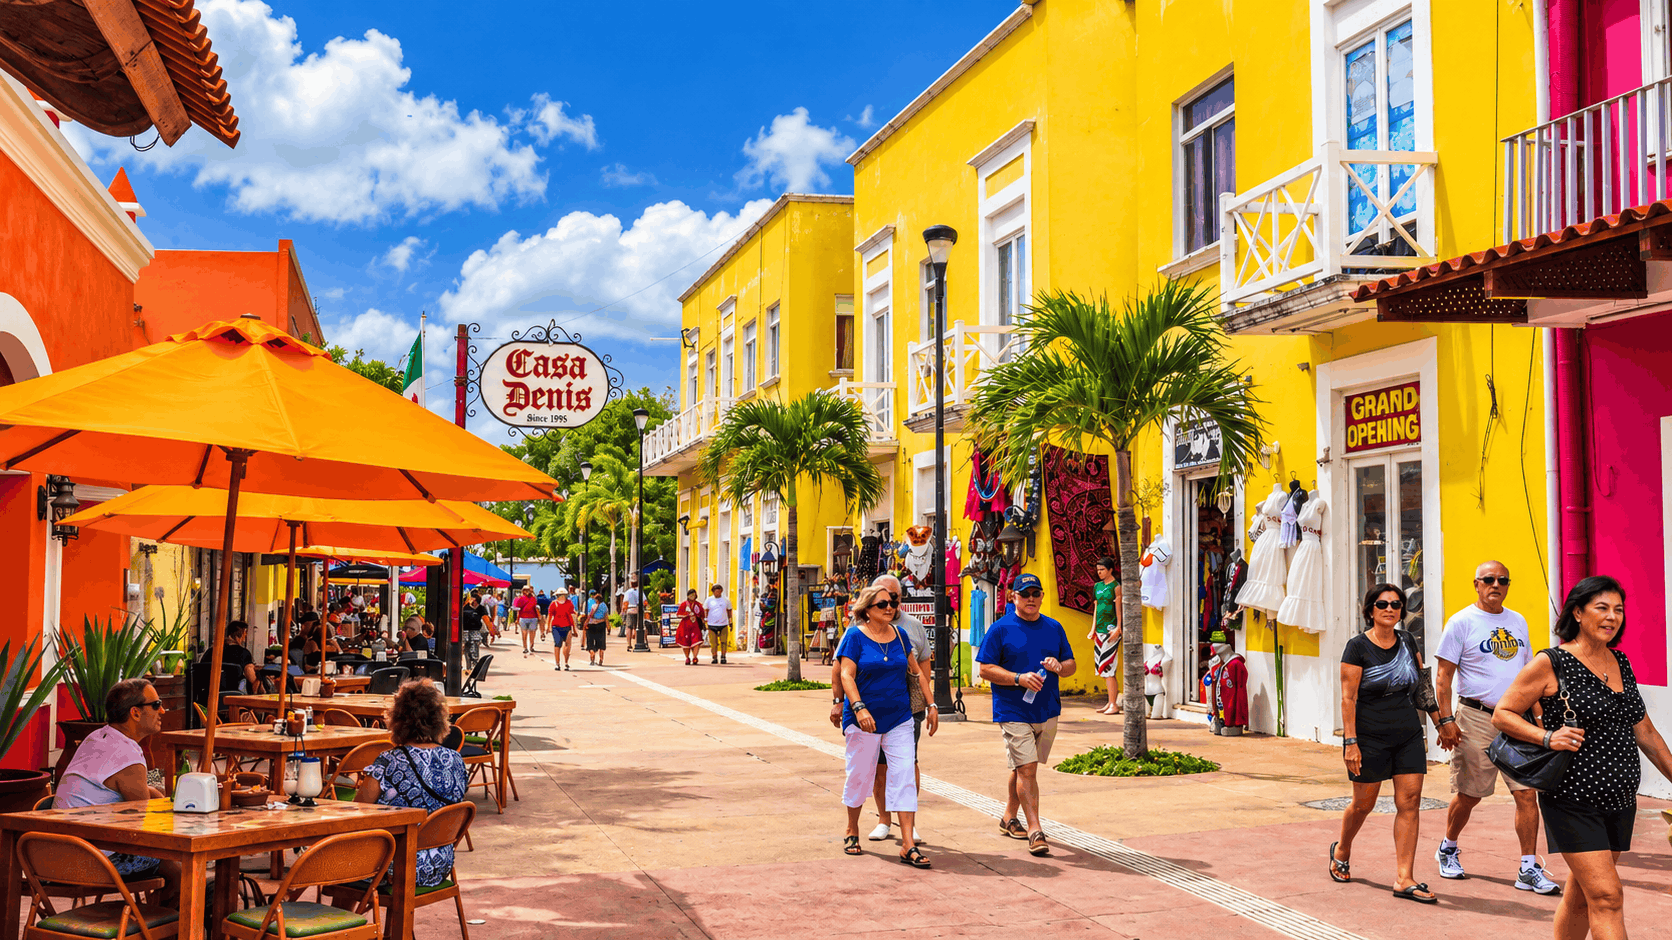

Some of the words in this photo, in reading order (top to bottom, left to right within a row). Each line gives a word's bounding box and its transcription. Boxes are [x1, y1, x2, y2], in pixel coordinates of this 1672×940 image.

[505, 349, 587, 380] Casa
[502, 381, 593, 417] Denis
[1351, 386, 1418, 421] GRAND
[526, 413, 548, 423] Since
